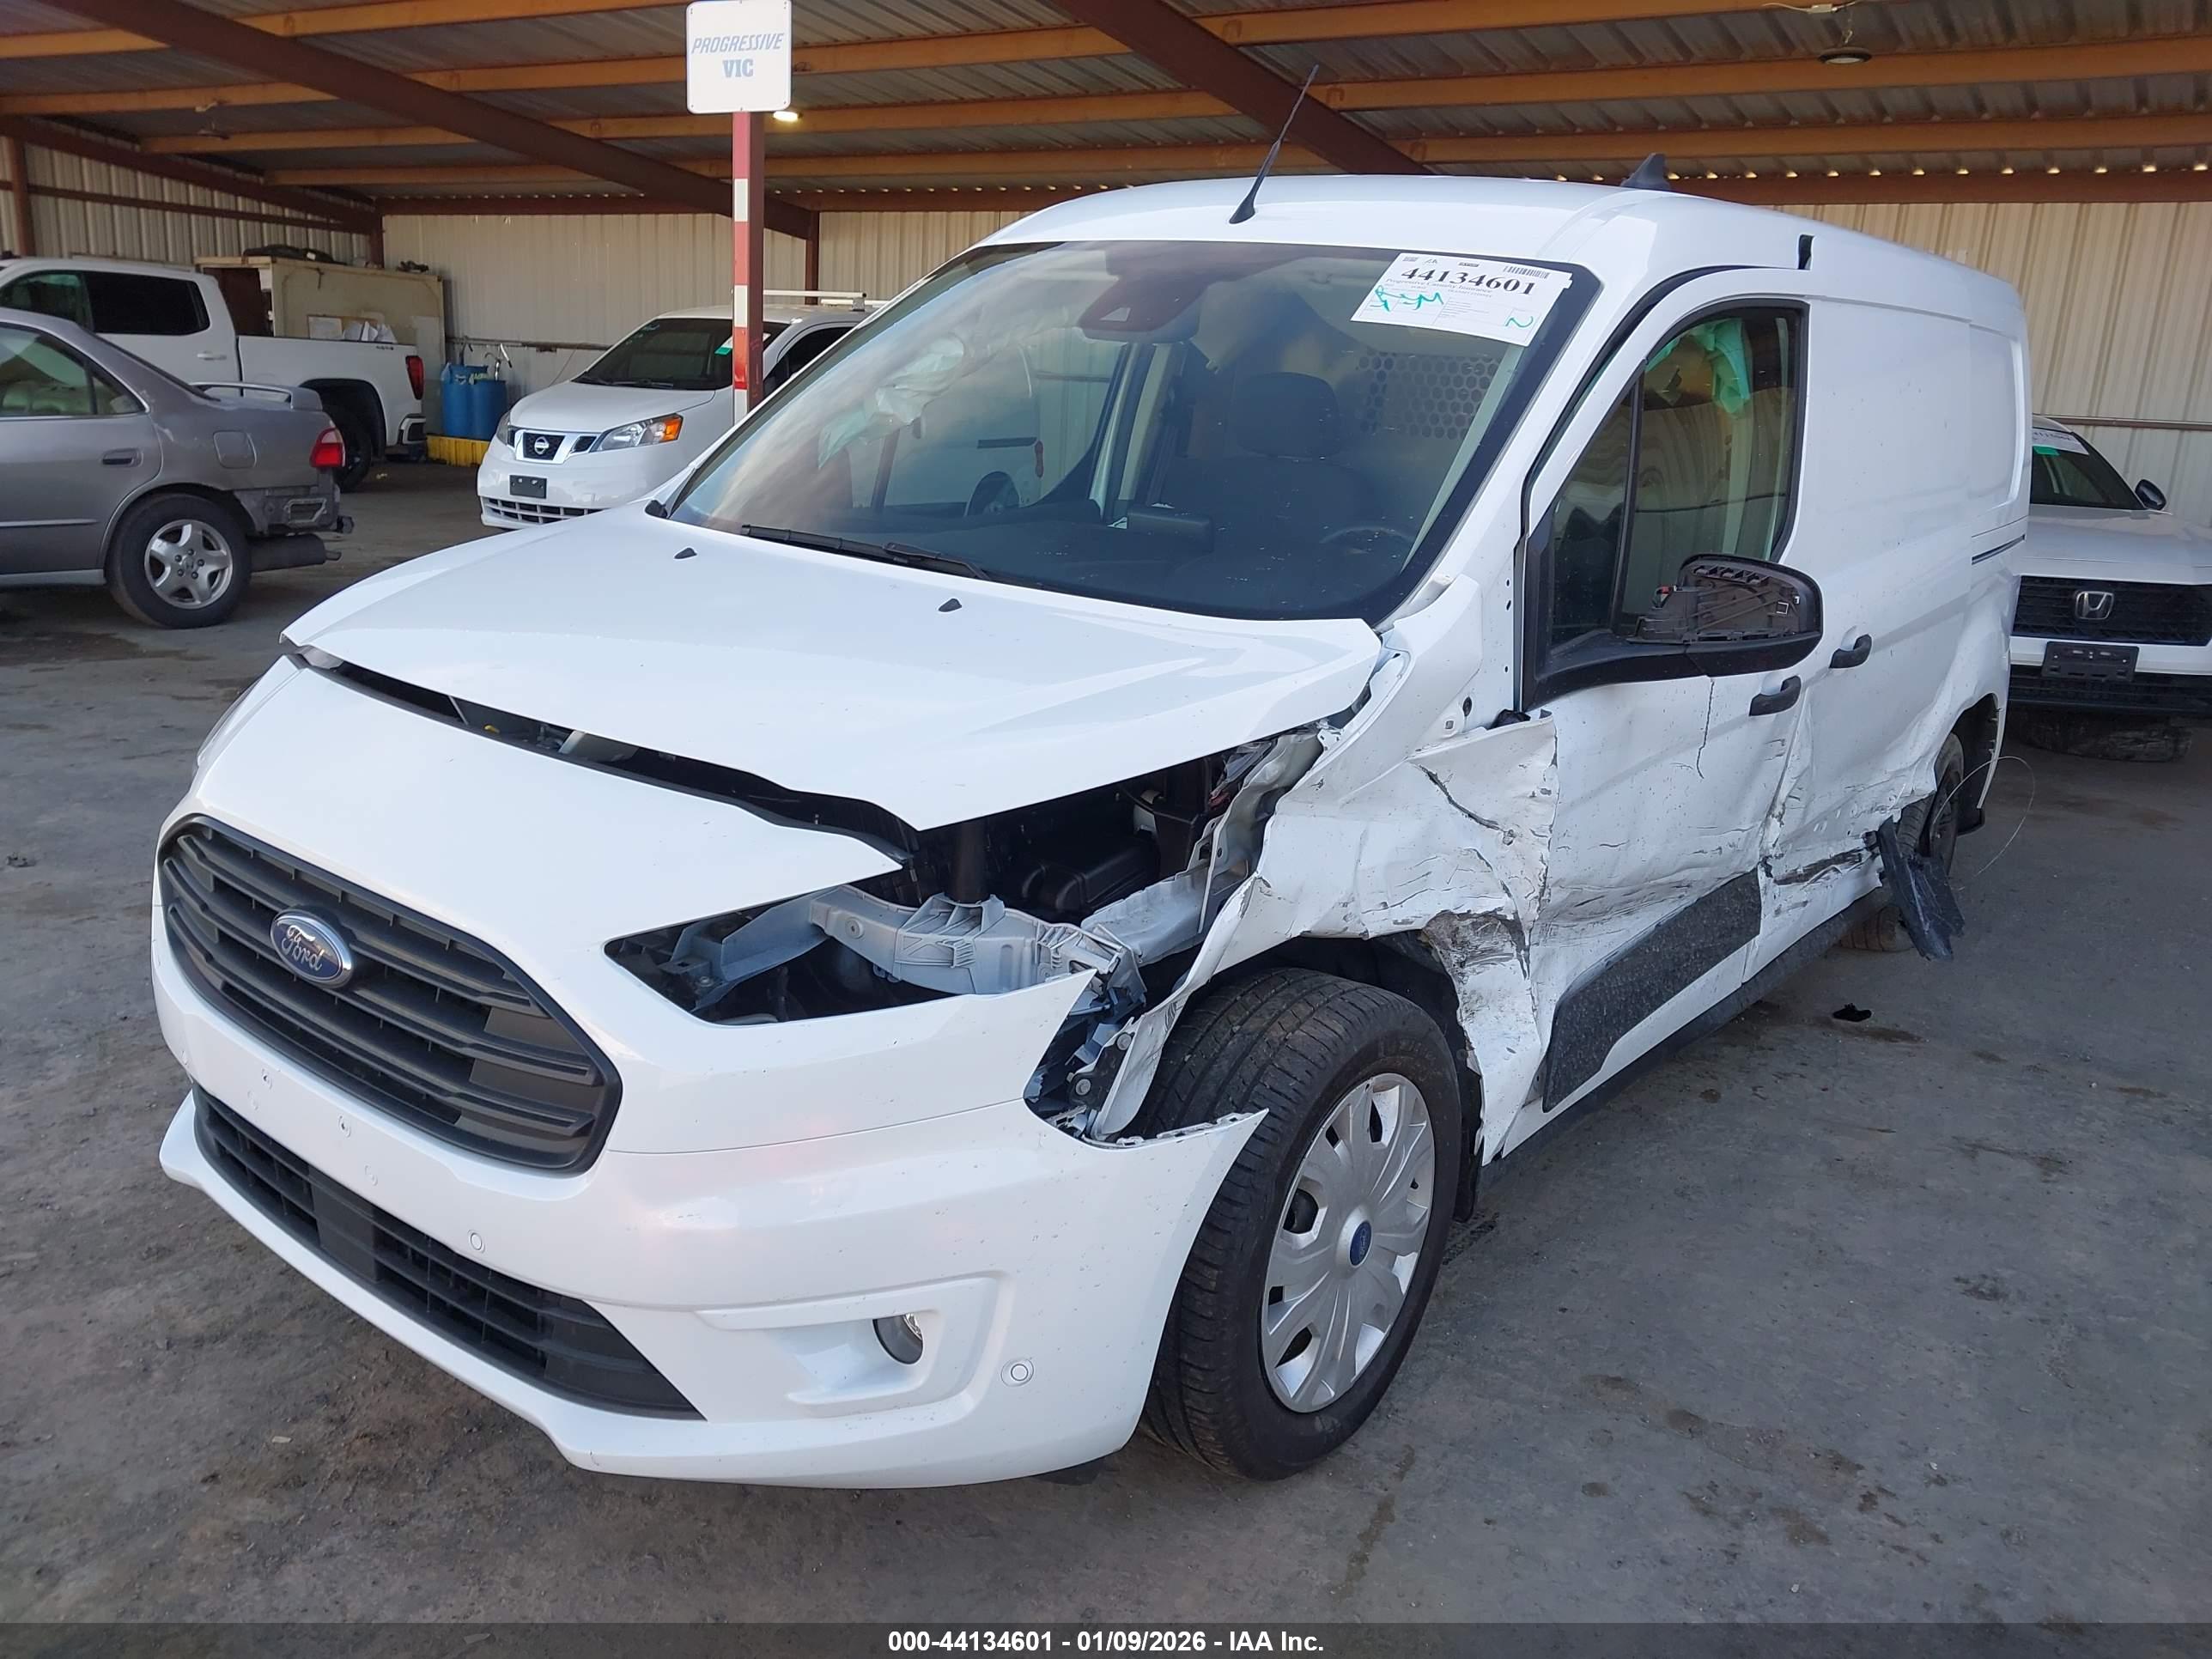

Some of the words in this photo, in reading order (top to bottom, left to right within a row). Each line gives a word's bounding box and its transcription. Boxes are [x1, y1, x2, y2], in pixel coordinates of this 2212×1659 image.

[691, 33, 785, 54] PROGRESSIVE
[722, 58, 754, 78] VIC
[1401, 268, 1535, 295] 44134601
[282, 925, 324, 970] Ford
